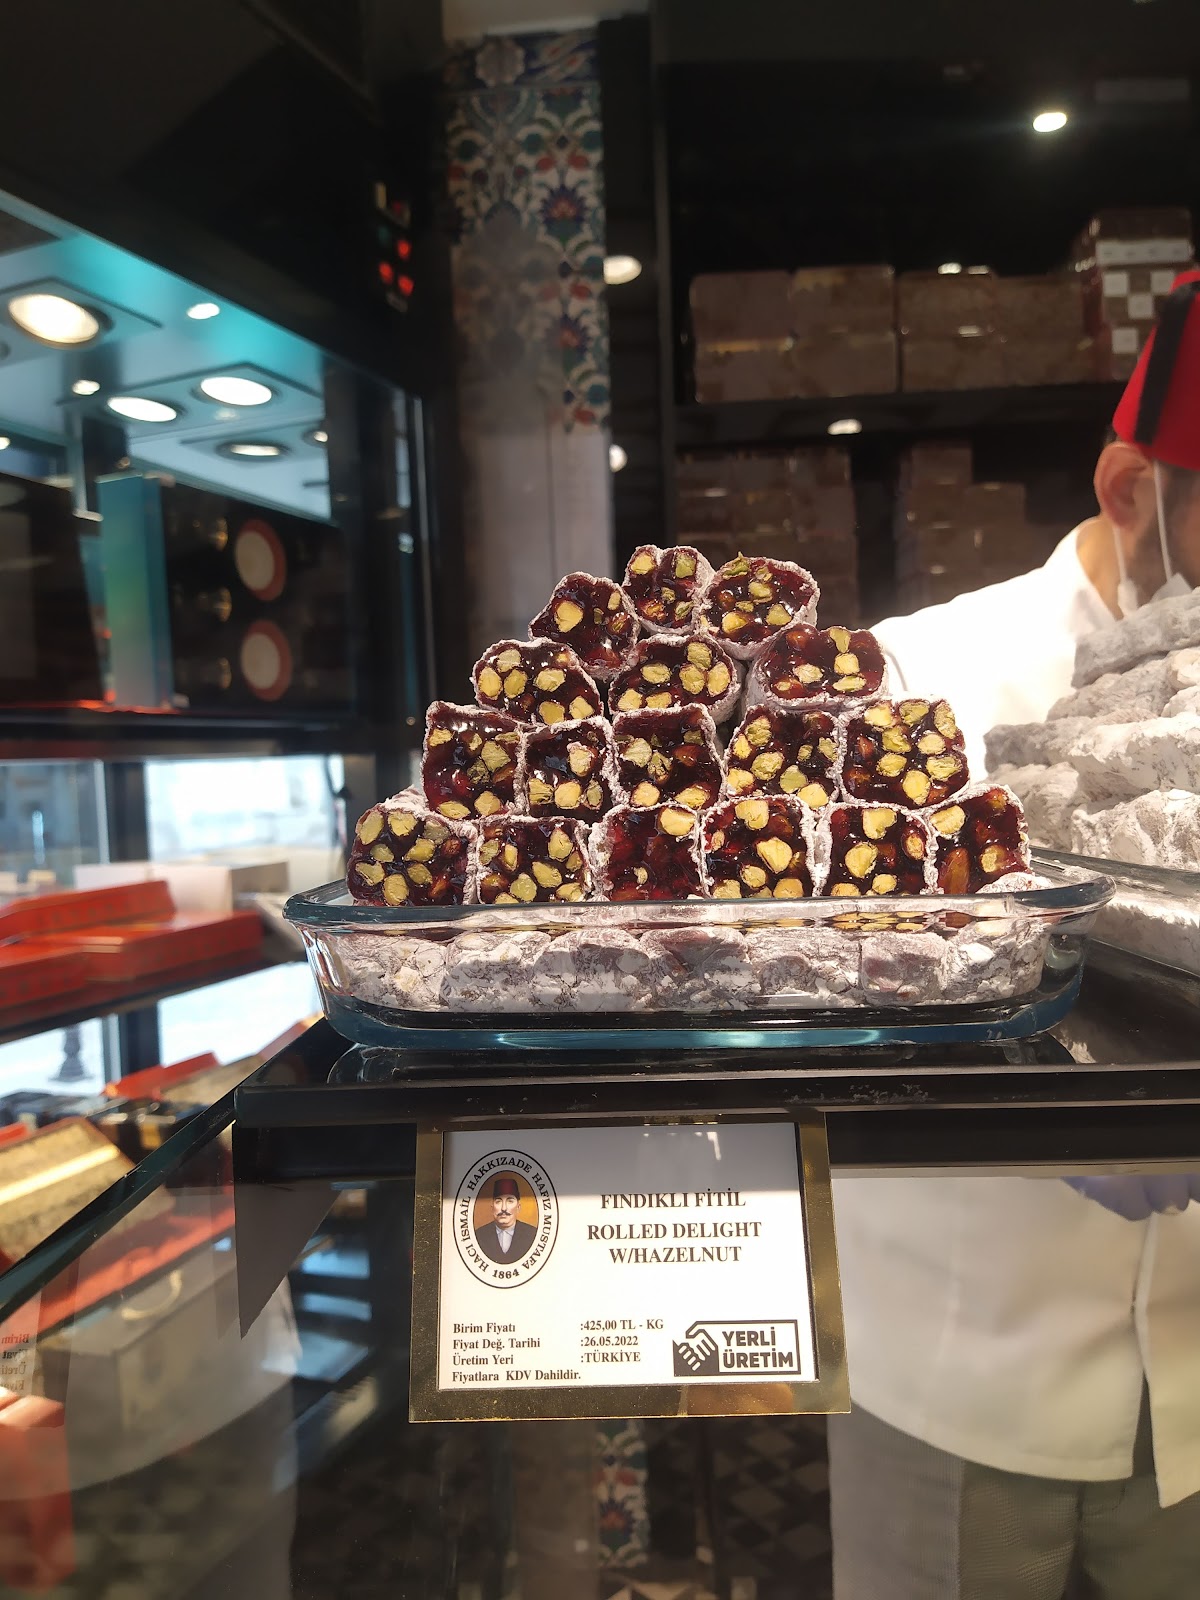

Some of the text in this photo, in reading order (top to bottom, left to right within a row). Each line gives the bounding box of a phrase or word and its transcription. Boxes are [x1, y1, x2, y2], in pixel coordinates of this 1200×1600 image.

[466, 1156, 533, 1191] HAKKIZADE
[531, 1172, 552, 1211] HAFIZ
[600, 1187, 746, 1209] FINDIKLI FİTİL
[587, 1221, 762, 1240] ROLLED DELIGHT
[521, 1214, 552, 1271] MUSTAFA
[465, 1243, 490, 1273] HACI
[609, 1246, 742, 1264] W/HAZELNUT
[491, 1268, 520, 1280] 1864
[453, 1322, 516, 1335] Birim Fiyatı
[580, 1320, 617, 1331] :425,00
[619, 1319, 636, 1330] TL
[646, 1318, 664, 1330] KG
[453, 1337, 541, 1352] Fiyat Değ. Tarihi
[580, 1335, 639, 1347] :26.05.2022
[722, 1326, 777, 1347] YERLİ
[453, 1352, 514, 1366] Üretim Yeri
[580, 1349, 641, 1363] :TÜRKİYE
[723, 1348, 794, 1369] ÜRETİM
[452, 1369, 581, 1384] Fiyatlara KDV Dahildir.
